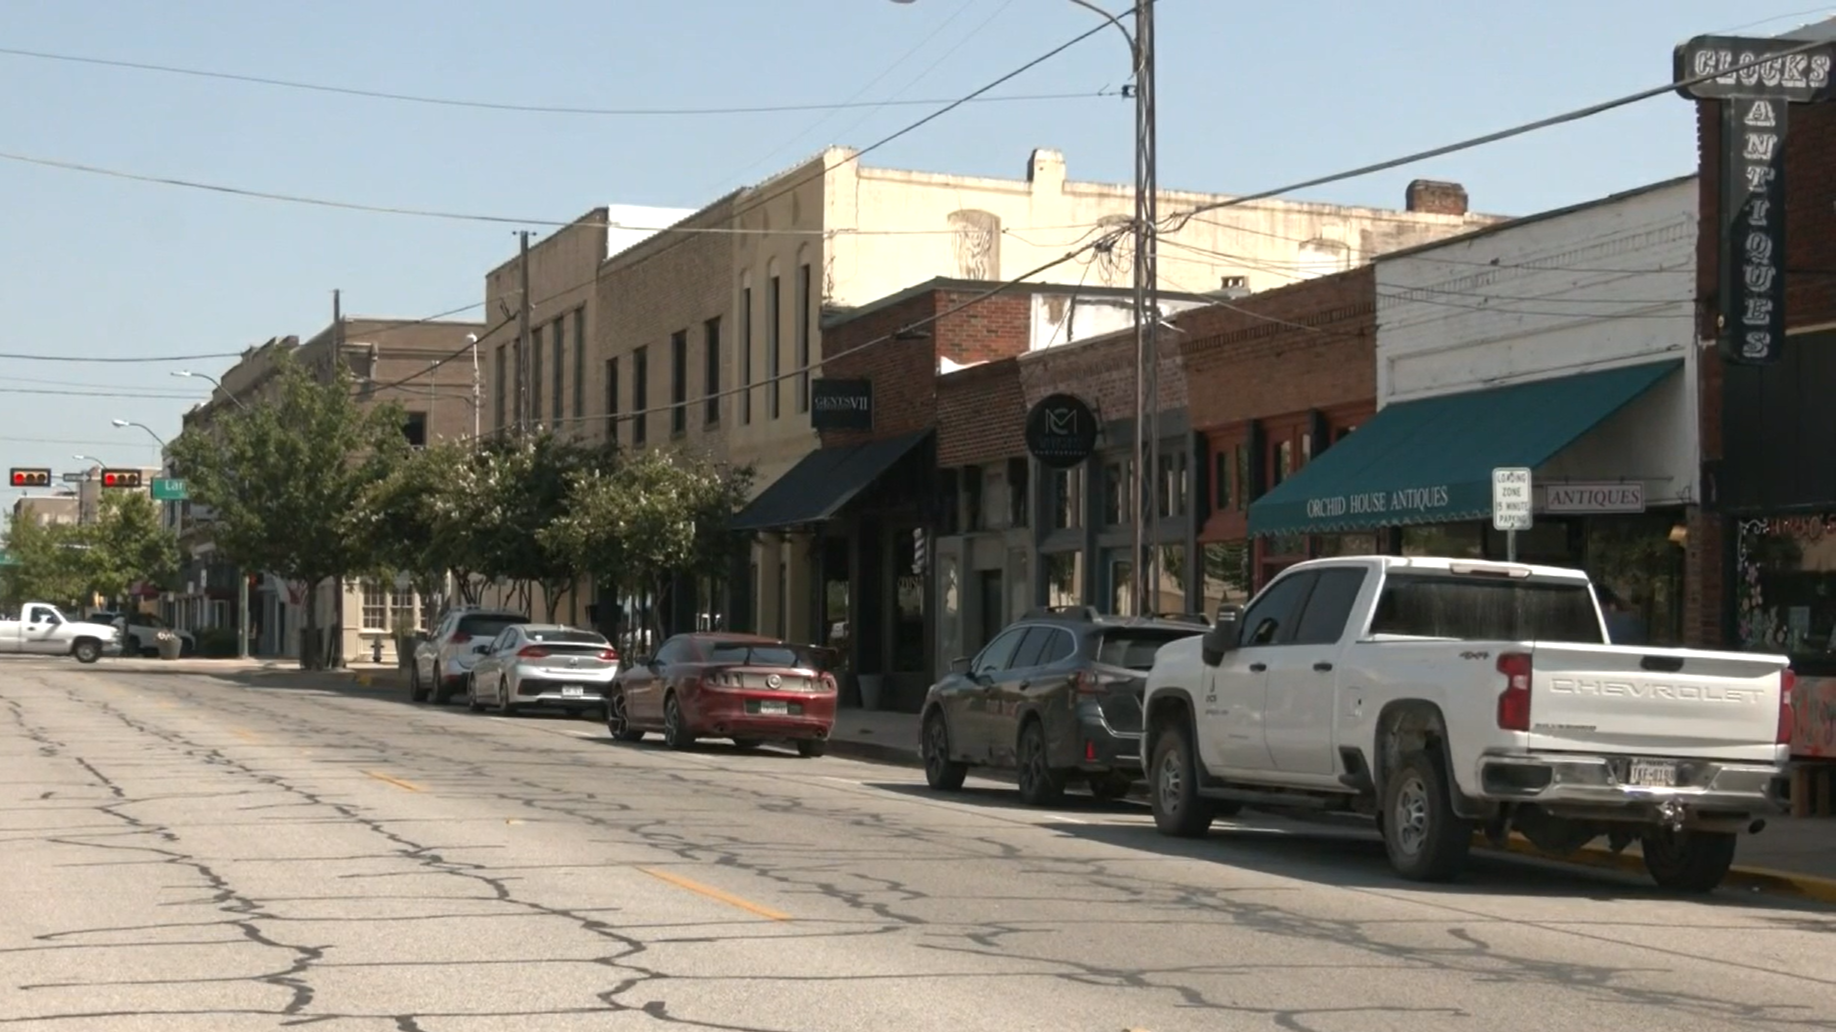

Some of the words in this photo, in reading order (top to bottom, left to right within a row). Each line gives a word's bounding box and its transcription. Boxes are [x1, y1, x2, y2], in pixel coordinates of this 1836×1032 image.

[1694, 50, 1831, 88] CLOCKS
[1743, 100, 1777, 358] ANTIQUES
[1497, 473, 1526, 483] LOADING
[1502, 487, 1521, 497] ZONE
[1551, 489, 1640, 507] ANTIQUES
[1307, 496, 1346, 518] ORCHID
[1350, 492, 1386, 514] HOUSE
[1390, 485, 1448, 512] ANTIQUES
[1506, 502, 1529, 511] MINUTE
[1499, 514, 1527, 524] PARKING
[1550, 678, 1765, 704] CHEVROLET
